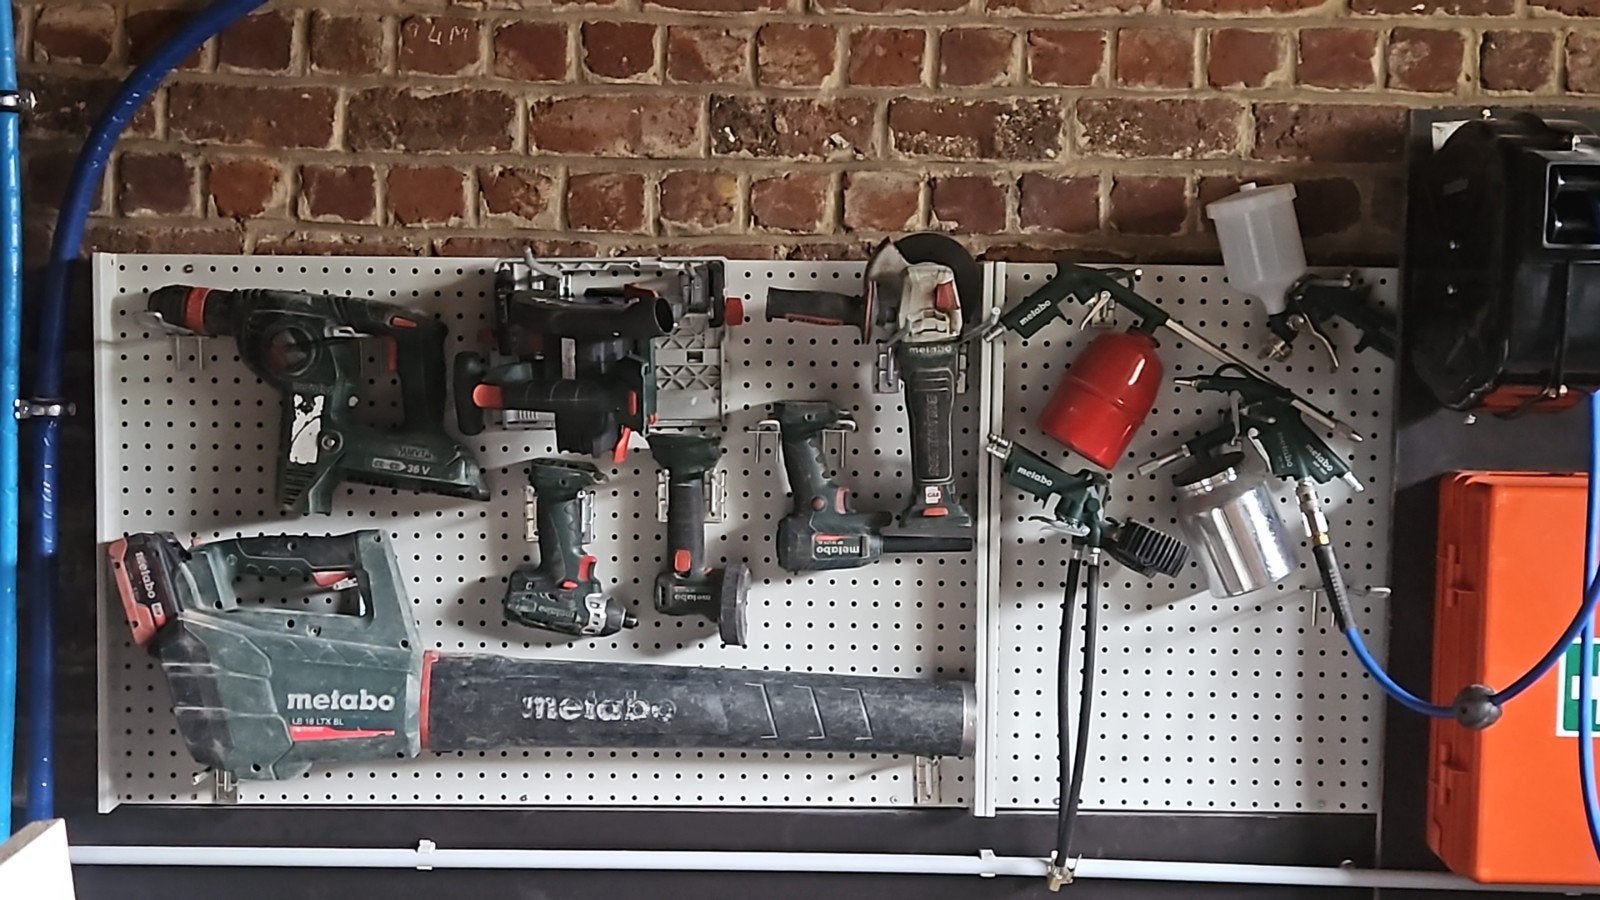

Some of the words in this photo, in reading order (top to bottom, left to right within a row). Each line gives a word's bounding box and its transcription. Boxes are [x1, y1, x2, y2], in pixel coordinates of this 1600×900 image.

[1019, 300, 1052, 326] metabo
[909, 345, 952, 354] metabo
[1305, 444, 1334, 472] metabo
[407, 464, 419, 473] 36
[422, 466, 430, 475] V
[1017, 466, 1053, 487] metabo
[816, 545, 860, 556] metabo
[135, 551, 156, 599] metabo
[674, 594, 711, 602] metabo
[287, 689, 396, 711] metabo
[521, 690, 677, 722] metabo
[305, 717, 315, 725] 18
[316, 717, 332, 726] LTX
[333, 718, 344, 726] BL
